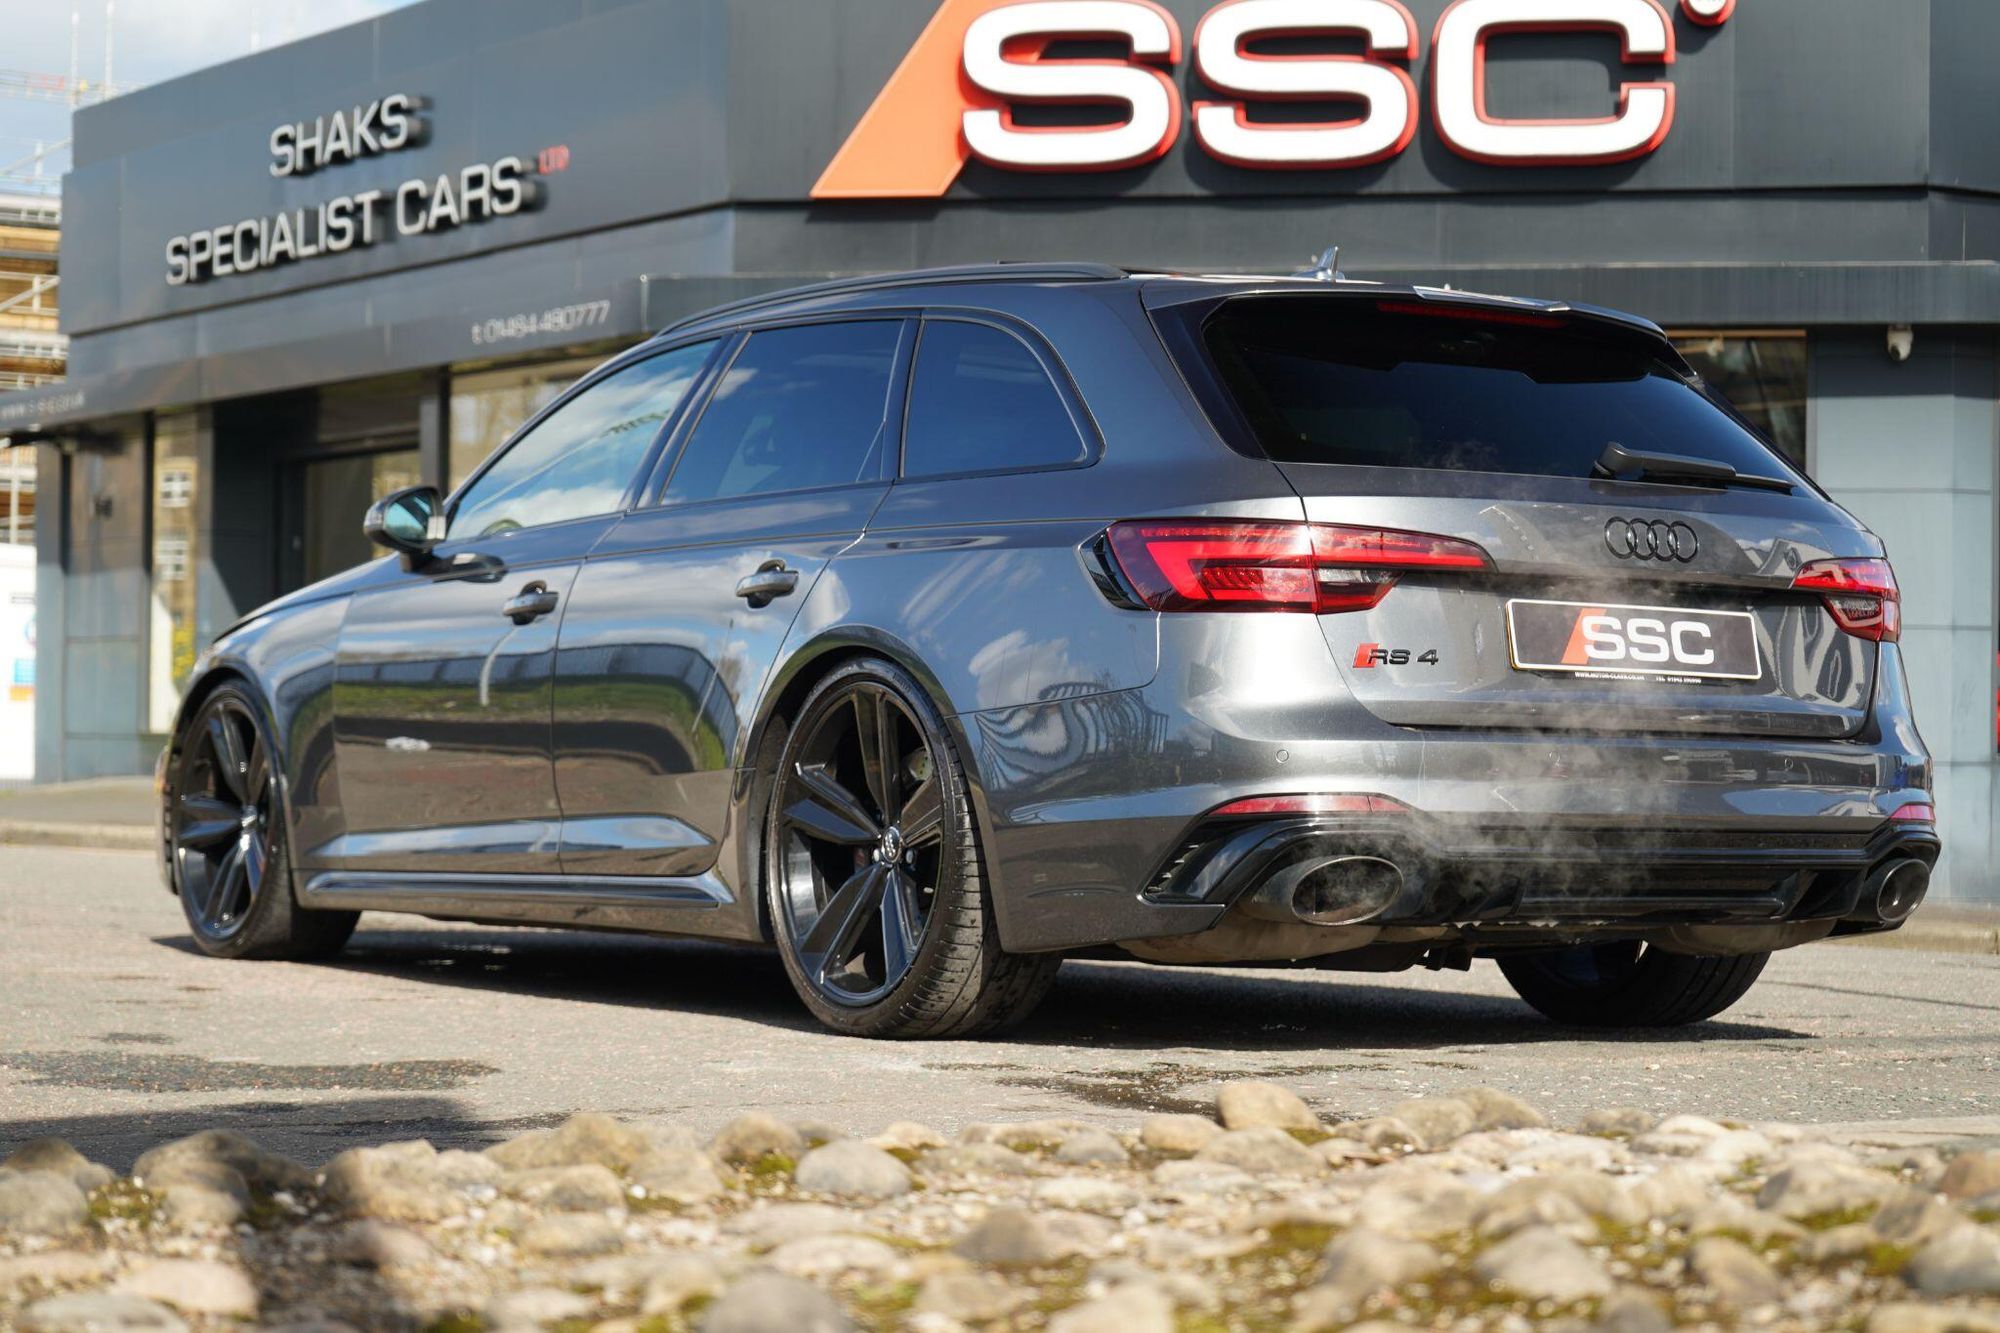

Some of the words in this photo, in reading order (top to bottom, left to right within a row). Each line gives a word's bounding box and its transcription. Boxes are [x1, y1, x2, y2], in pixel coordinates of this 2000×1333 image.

[269, 93, 409, 177] SHAKS
[961, 0, 1675, 168] SSC
[165, 189, 381, 285] SPECIALIST
[396, 156, 522, 235] CARS
[1581, 616, 1715, 664] SSC
